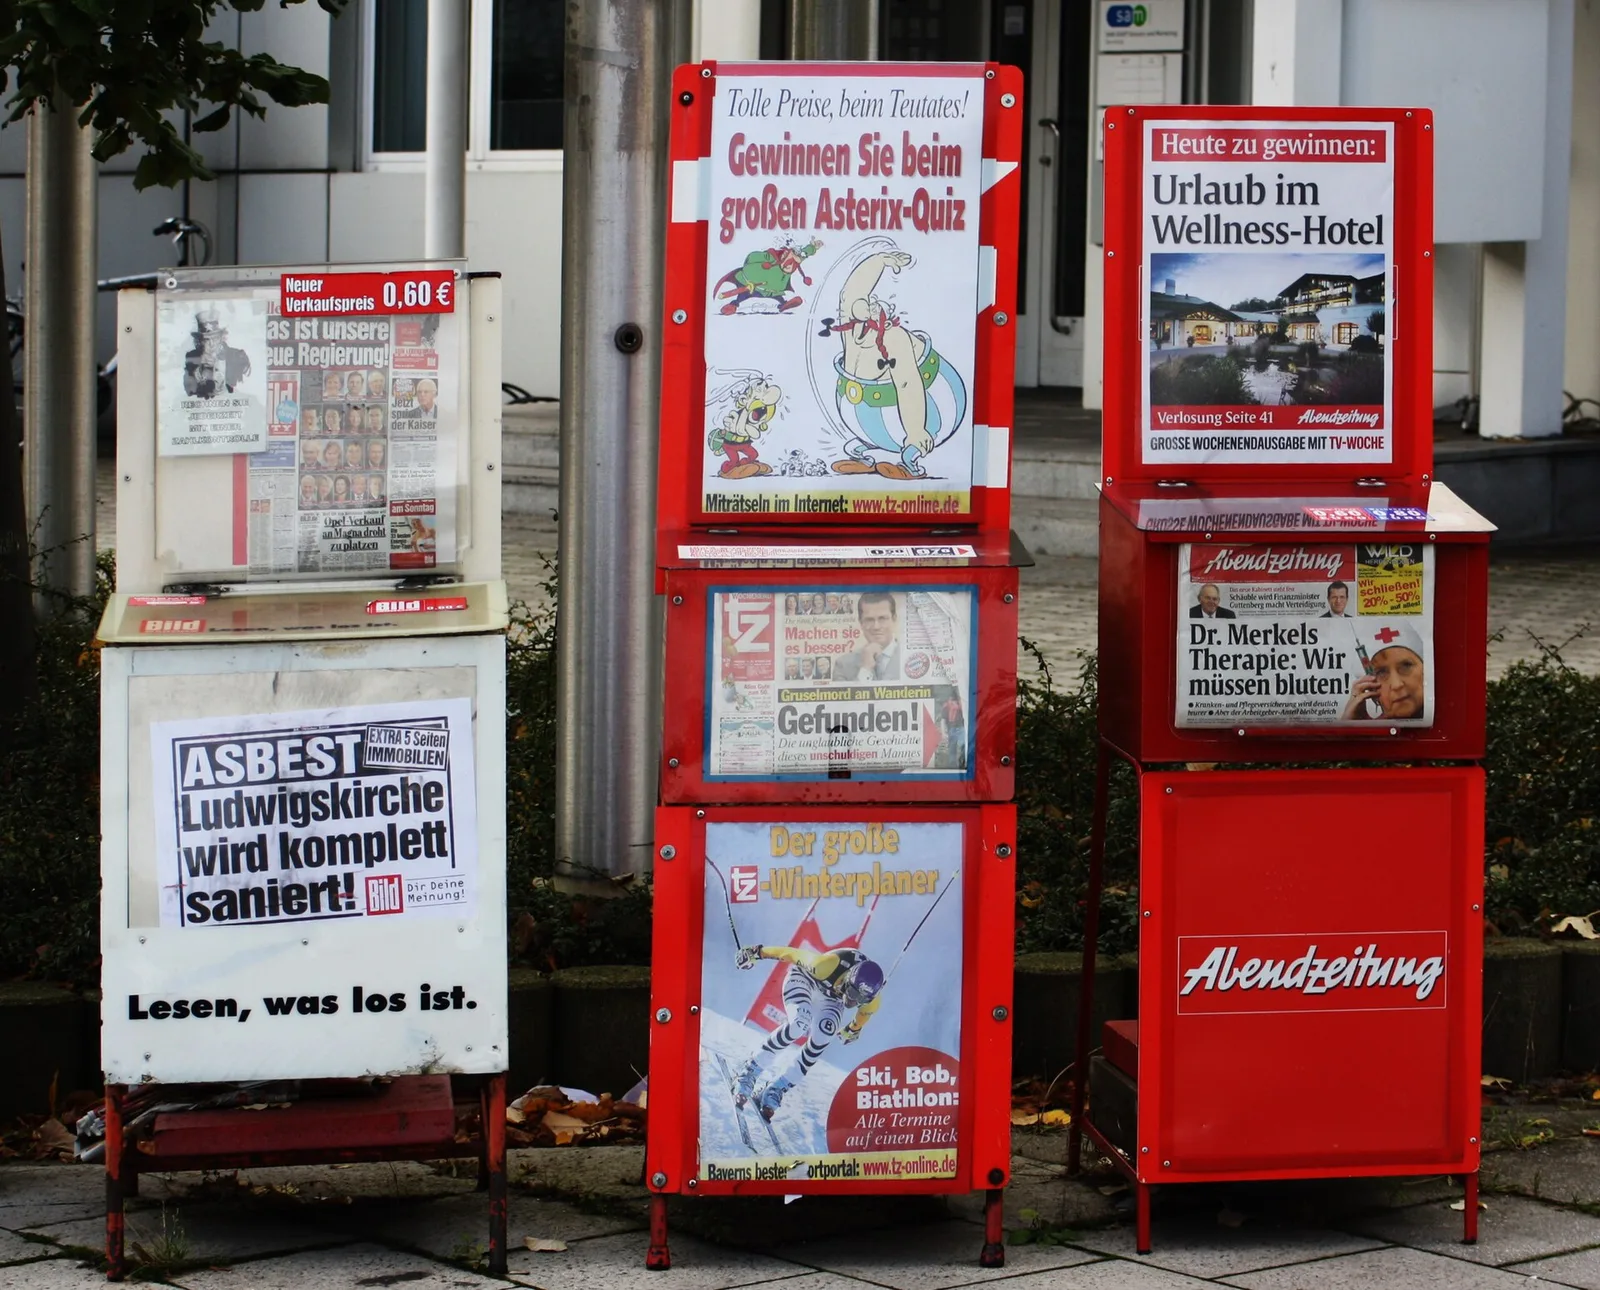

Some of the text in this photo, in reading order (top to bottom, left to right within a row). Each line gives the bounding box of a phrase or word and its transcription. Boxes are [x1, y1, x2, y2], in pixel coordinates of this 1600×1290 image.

[728, 88, 970, 123] Tolle Preise, beim Teutates!
[728, 130, 962, 178] Gewinnen Sie beim
[1161, 133, 1376, 159] Heute zu gewinnen:
[1153, 173, 1320, 206] Urlaub im
[720, 183, 966, 244] großen Asterix-Quiz
[1151, 214, 1384, 245] Wellness-Hotel
[286, 277, 323, 293] Neuer
[286, 281, 451, 312] Verkaufspreis 0,60 €
[267, 318, 389, 341] as ist unsere
[267, 342, 389, 368] eue Regierung!
[391, 420, 436, 430] der Kaiser
[1157, 409, 1379, 427] Verlosung Seite 41 Abendzeitung
[1150, 436, 1384, 451] GROSSE WOCHENENDAUSGABE MIT TV-WOCHE
[391, 505, 403, 514] am
[405, 503, 434, 514] Sonntag
[705, 493, 960, 514] Miträtseln im Internet: www.tz-online.de
[323, 527, 386, 541] an Magna droht
[331, 540, 378, 552] zu platzen
[1204, 547, 1343, 577] Abendzeitung
[1358, 579, 1373, 588] Wir
[1360, 579, 1420, 597] schließen!
[376, 600, 420, 613] Bild
[1229, 601, 1264, 609] Guttenberg
[1285, 601, 1326, 609] Verteidigung
[1364, 596, 1388, 608] 20%
[1395, 591, 1420, 603] 50%
[145, 620, 200, 631] Bild
[724, 593, 772, 652] tz
[785, 626, 860, 640] Machen sie
[1190, 622, 1318, 646] Dr. Merkels
[785, 640, 854, 655] es besser?
[1189, 648, 1346, 675] Therapie: Wir
[781, 686, 931, 701] Gruselmord an Wanderin
[1189, 673, 1350, 696] müssen bluten!
[1195, 701, 1224, 709] Kranken-
[1318, 708, 1336, 716] gleich
[778, 702, 919, 735] Gefunden!
[369, 727, 446, 748] EXTRA 5 Seiten
[778, 735, 921, 750] Die unglaubliche Geschichte
[182, 733, 361, 788] ASBEST
[367, 746, 445, 766] IMMOBILIEN
[778, 748, 921, 761] dieses unschuldigen Mannes
[181, 777, 444, 832] Ludwigskirche
[183, 820, 448, 878] wird komplett
[770, 823, 899, 866] Der große
[407, 878, 465, 893] Dir Deine
[731, 867, 757, 901] tz
[186, 872, 357, 924] saniert!
[369, 878, 401, 912] Bild
[407, 889, 466, 904] Meinung!
[1180, 944, 1443, 1000] Abendzeitung
[128, 983, 478, 1023] Lesen, was los ist.
[856, 1064, 957, 1088] Ski, Bob,
[857, 1088, 959, 1109] Biathlon:
[855, 1112, 951, 1129] Alle Termine
[846, 1130, 958, 1147] auf einen Blick
[808, 1158, 860, 1180] ortportal:
[863, 1155, 956, 1175] www.tz-online.de
